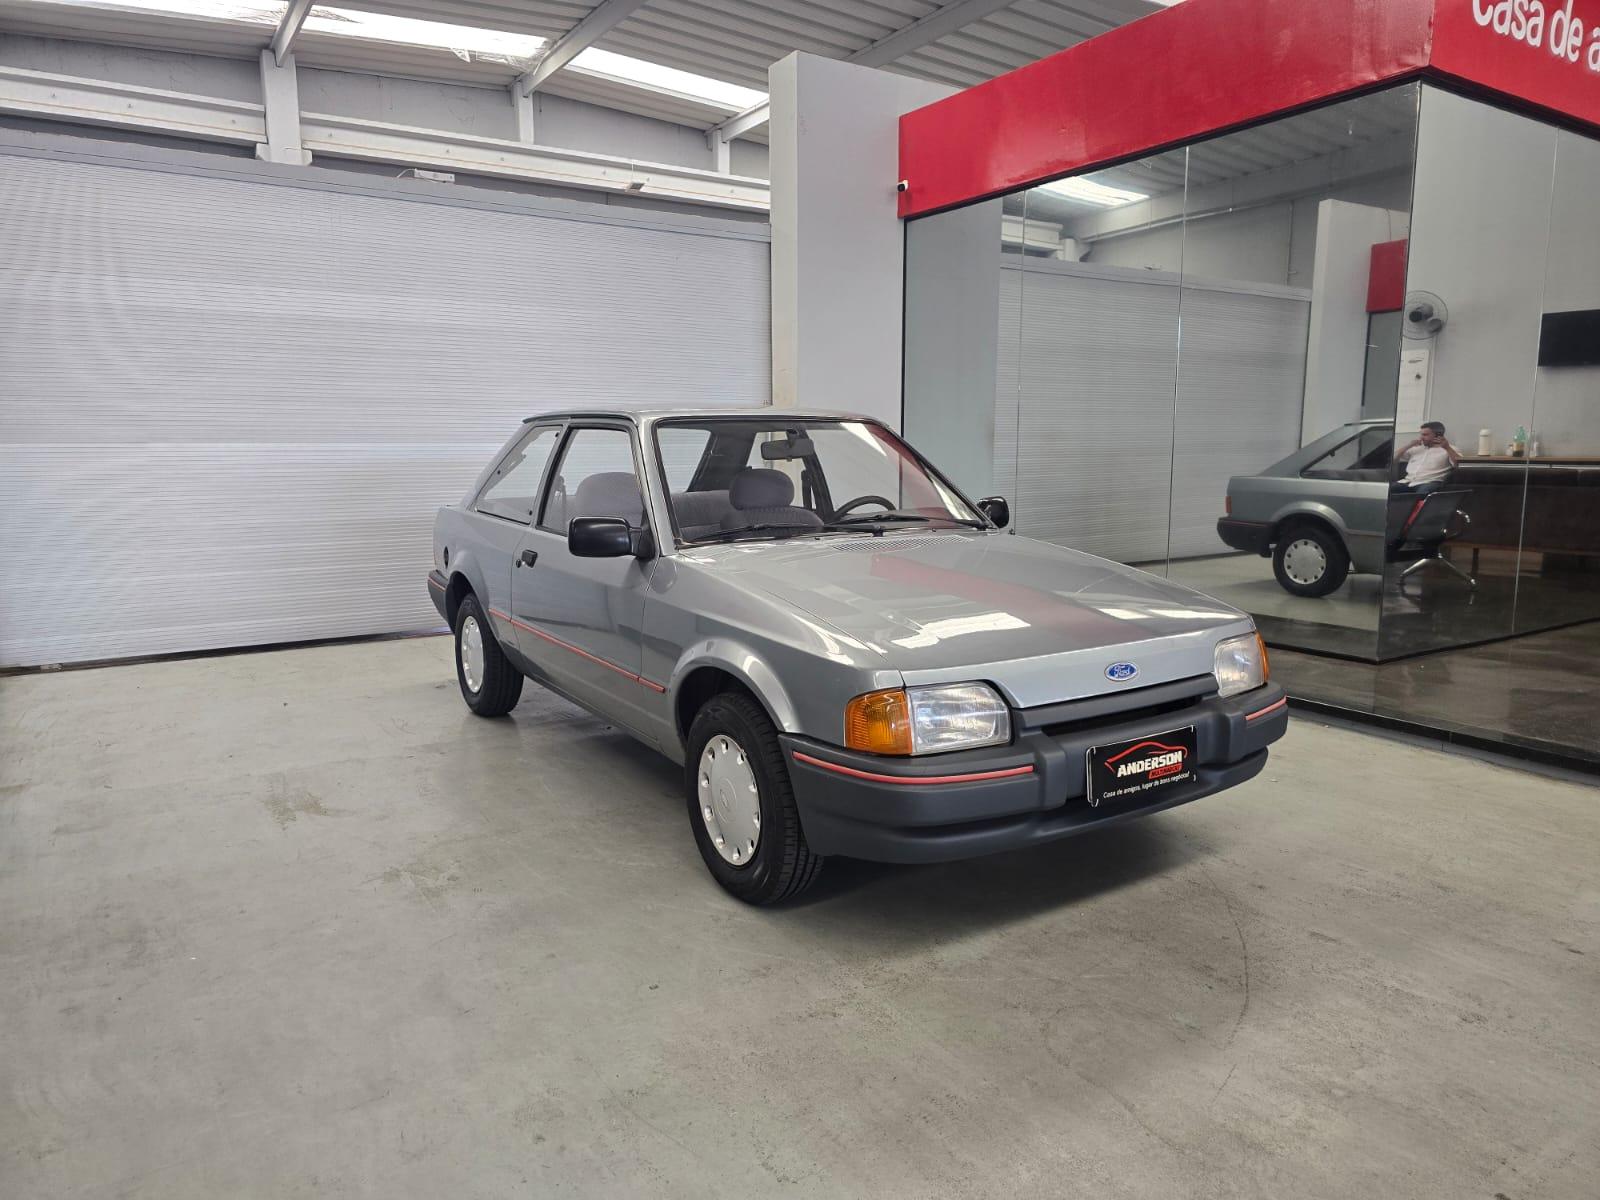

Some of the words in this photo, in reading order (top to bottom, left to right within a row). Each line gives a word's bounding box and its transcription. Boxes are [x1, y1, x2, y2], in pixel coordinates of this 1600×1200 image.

[1472, 0, 1545, 47] Casa
[1550, 0, 1584, 62] de
[1117, 751, 1183, 778] ANDERSON
[1103, 791, 1116, 799] Casa
[1141, 782, 1153, 790] lugar
